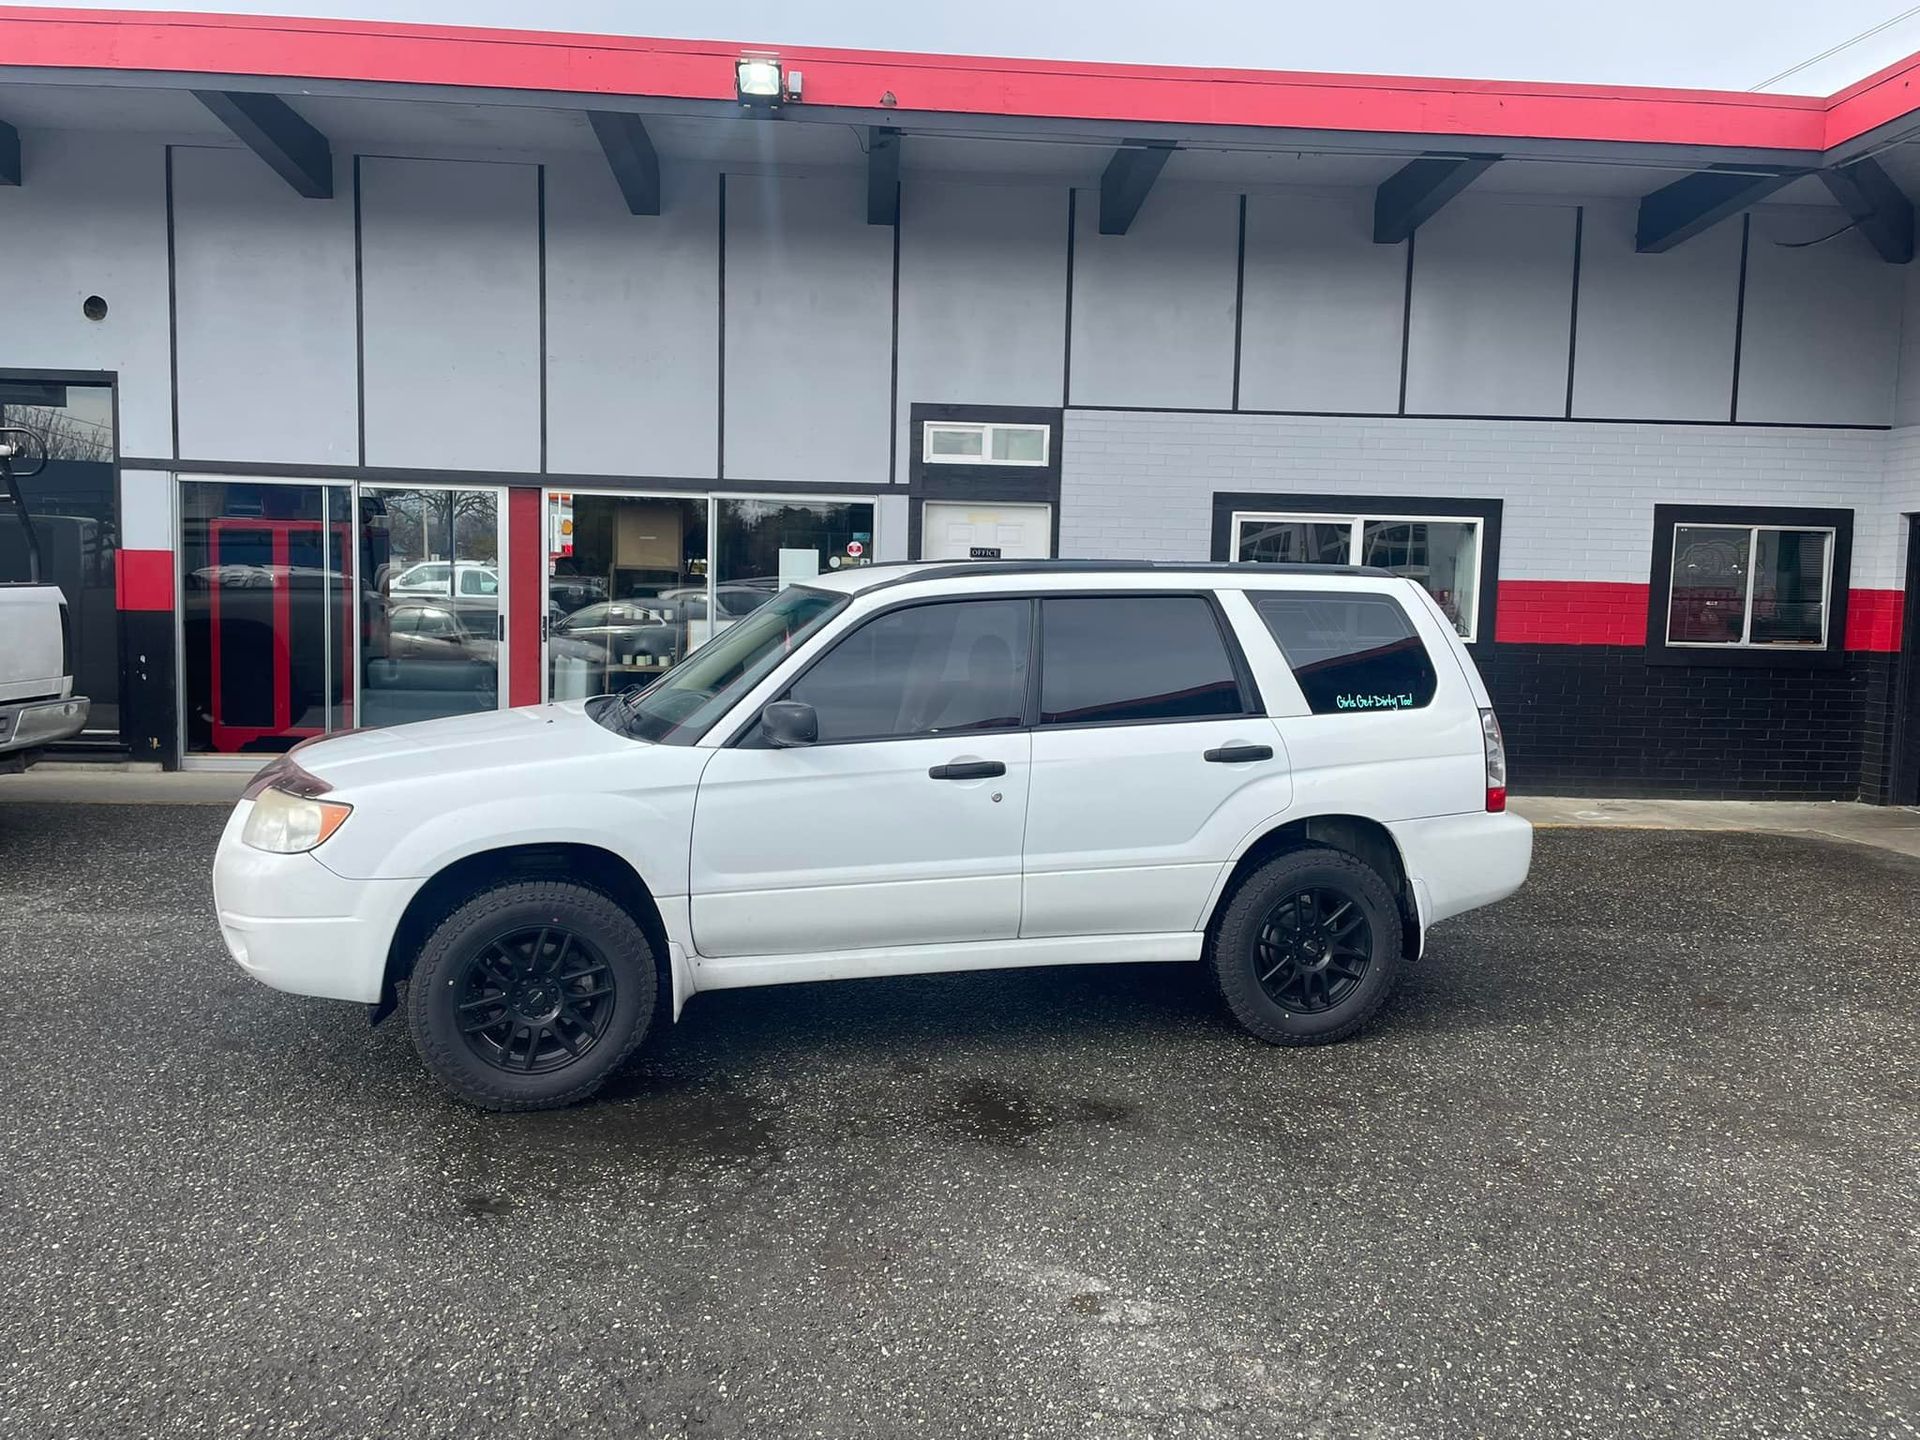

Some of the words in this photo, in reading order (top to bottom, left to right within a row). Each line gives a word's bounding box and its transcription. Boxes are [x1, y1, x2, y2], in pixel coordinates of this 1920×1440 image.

[972, 549, 999, 557] OFFICE
[1336, 693, 1356, 708] Girls
[1356, 694, 1374, 708] Get
[1374, 694, 1397, 711] Dirty
[1397, 692, 1413, 706] Too!
